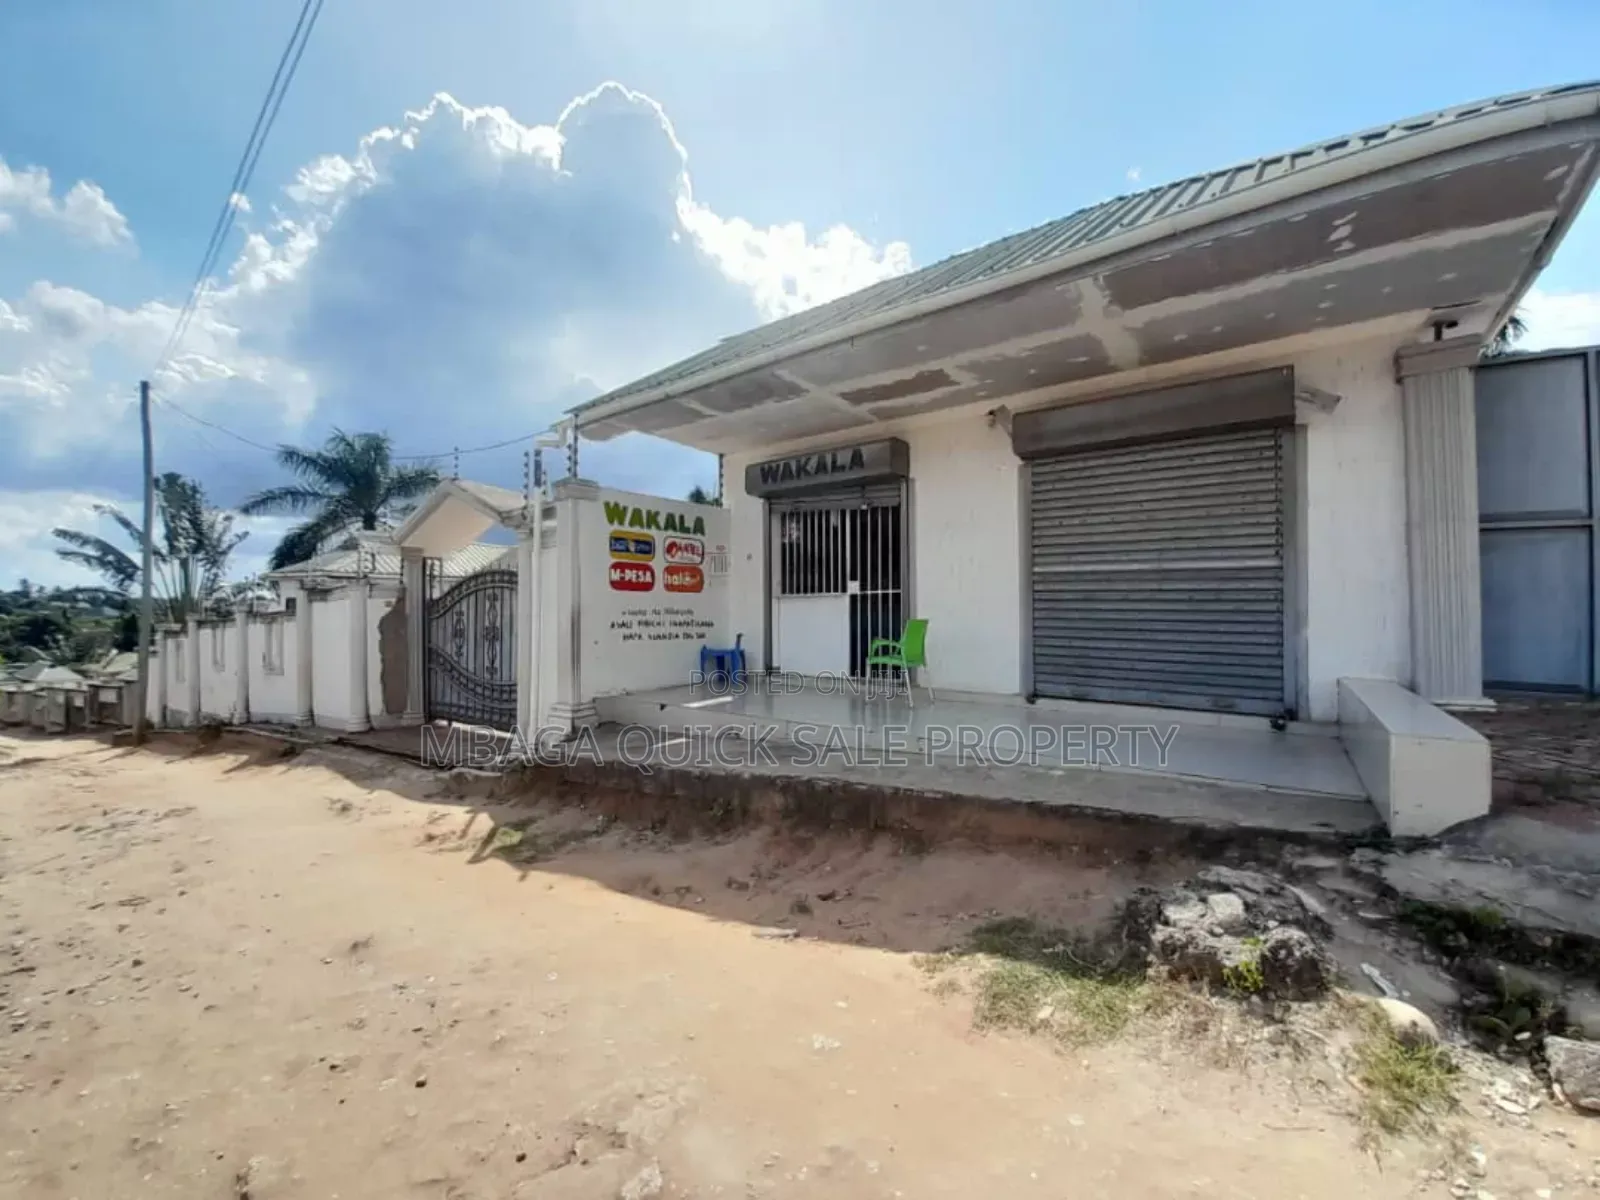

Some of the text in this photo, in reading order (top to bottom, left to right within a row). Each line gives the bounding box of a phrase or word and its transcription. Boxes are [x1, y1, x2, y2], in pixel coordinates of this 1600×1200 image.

[760, 448, 864, 485] WAKALA
[603, 500, 705, 536] WAKALA
[611, 568, 653, 583] M-PESA
